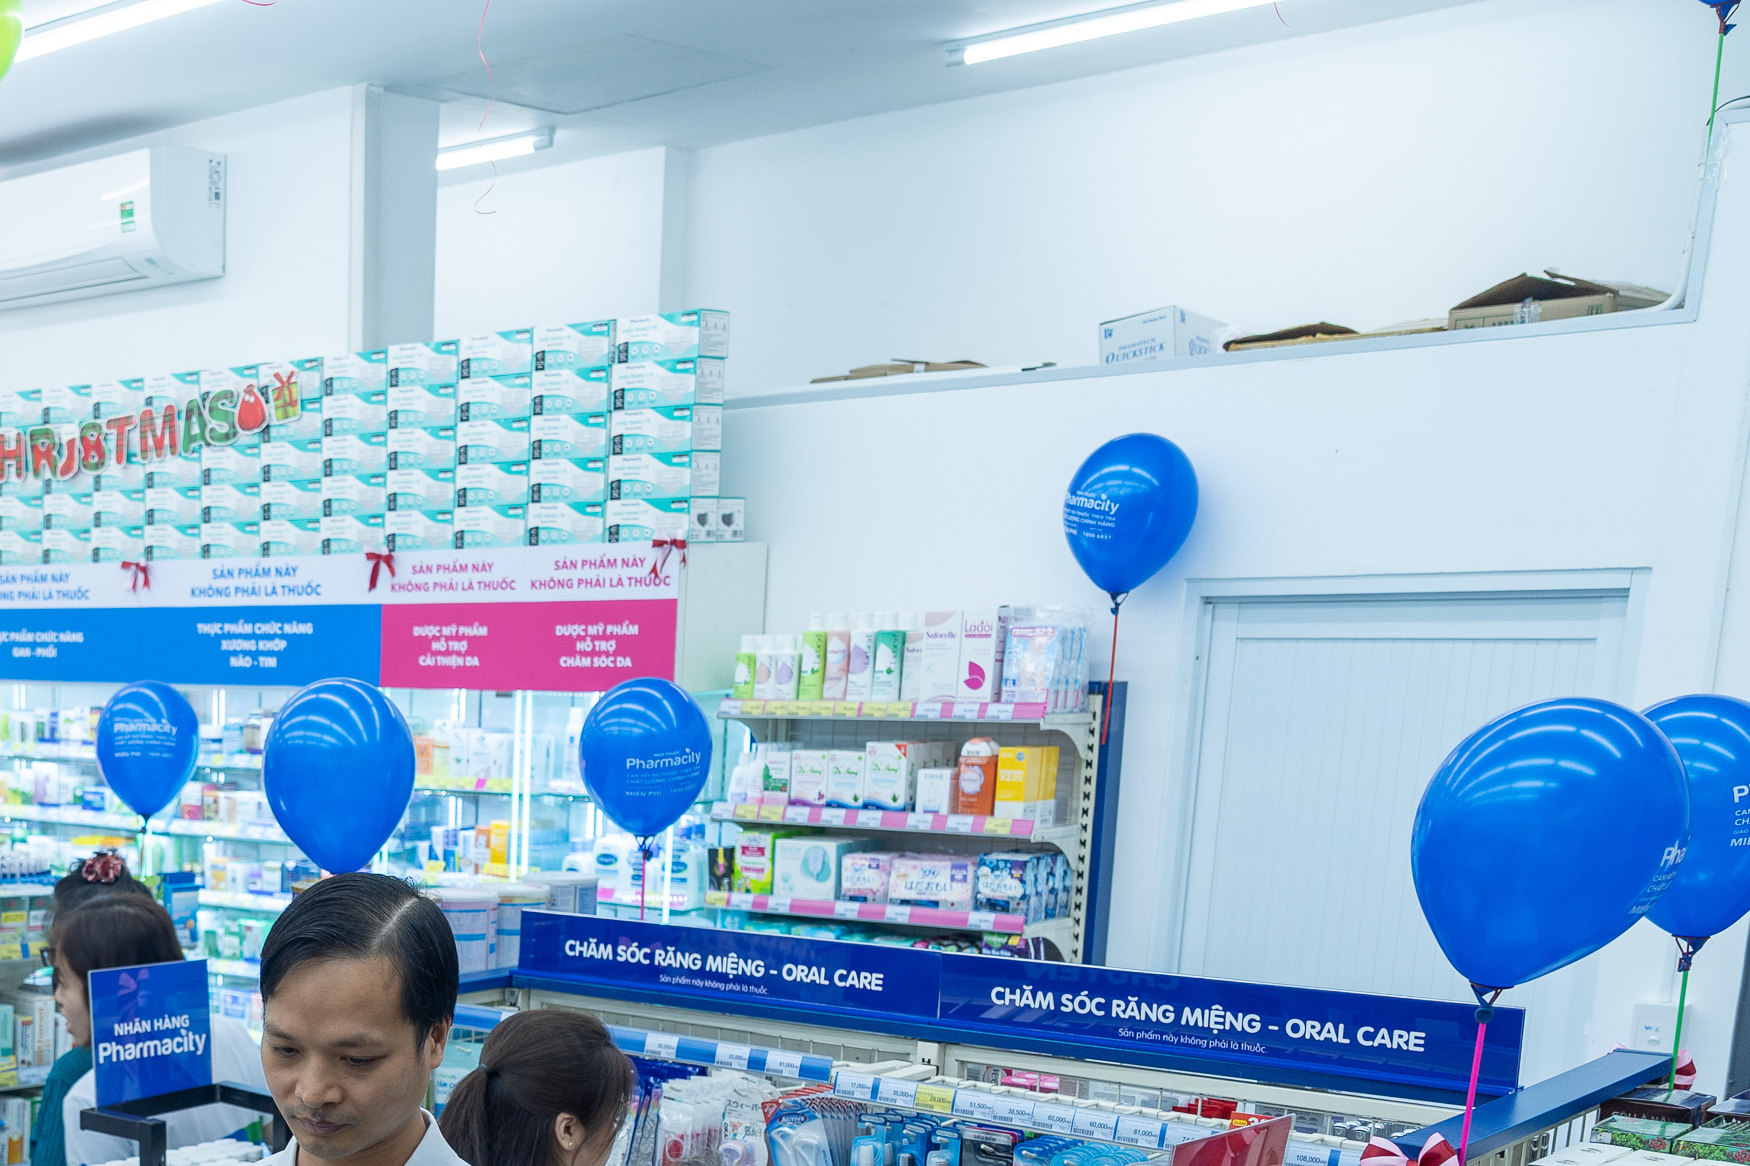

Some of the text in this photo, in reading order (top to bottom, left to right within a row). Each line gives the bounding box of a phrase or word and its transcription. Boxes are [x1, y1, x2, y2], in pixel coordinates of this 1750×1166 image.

[412, 558, 494, 574] SẢN PHẨM NÀY
[554, 552, 646, 570] SẢN PHẨM NÀY
[213, 561, 298, 580] SẢN PHẨM NÀY
[191, 579, 321, 598] KHÔNG PHẢI LÀ THUỐC
[391, 575, 516, 593] KHÔNG PHẢI LÀ THUỐC
[531, 574, 671, 590] KHÔNG PHẢI LÀ THUỐC
[42, 589, 54, 600] LÀ
[56, 587, 90, 600] THUỐC
[197, 622, 220, 637] THỰC
[223, 618, 252, 635] PHẨM
[284, 622, 313, 635] NĂNG
[458, 621, 487, 636] PHẨM
[588, 621, 604, 635] MỸ
[606, 619, 638, 635] PHẨM
[576, 636, 615, 654] HỖ TRỢ
[260, 656, 277, 668] TIM
[461, 656, 479, 666] DA
[560, 654, 632, 668] CHĂM SÓC DA
[114, 718, 178, 736] Pharmacity
[626, 748, 701, 769] Pharmacity
[565, 938, 613, 960] CHĂM
[617, 942, 651, 966] SÓC
[655, 947, 702, 971] RĂNG
[706, 953, 765, 979] MIỆNG
[782, 963, 829, 985] ORAL
[833, 969, 884, 991] CARE
[659, 974, 671, 983] Sản
[672, 975, 691, 985] phẩm
[692, 978, 704, 988] này
[704, 978, 725, 990] không
[726, 982, 741, 993] phải
[742, 984, 748, 992] là
[114, 1014, 190, 1036] NHÃN HÀNG
[991, 984, 1055, 1010] CHĂM
[1060, 991, 1105, 1017] SÓC
[1111, 996, 1174, 1023] RĂNG
[1181, 1005, 1261, 1034] MIỆNG
[1286, 1018, 1350, 1044] ORAL
[1356, 1026, 1426, 1052] CARE
[98, 1029, 206, 1064] Pharmacity
[1118, 1027, 1135, 1038] Sản
[1136, 1029, 1161, 1041] phẩm
[1162, 1032, 1179, 1044] này
[1180, 1034, 1207, 1048] không
[1208, 1038, 1228, 1050] phải
[1230, 1040, 1239, 1050] là
[779, 1115, 805, 1123] ACTIVE
